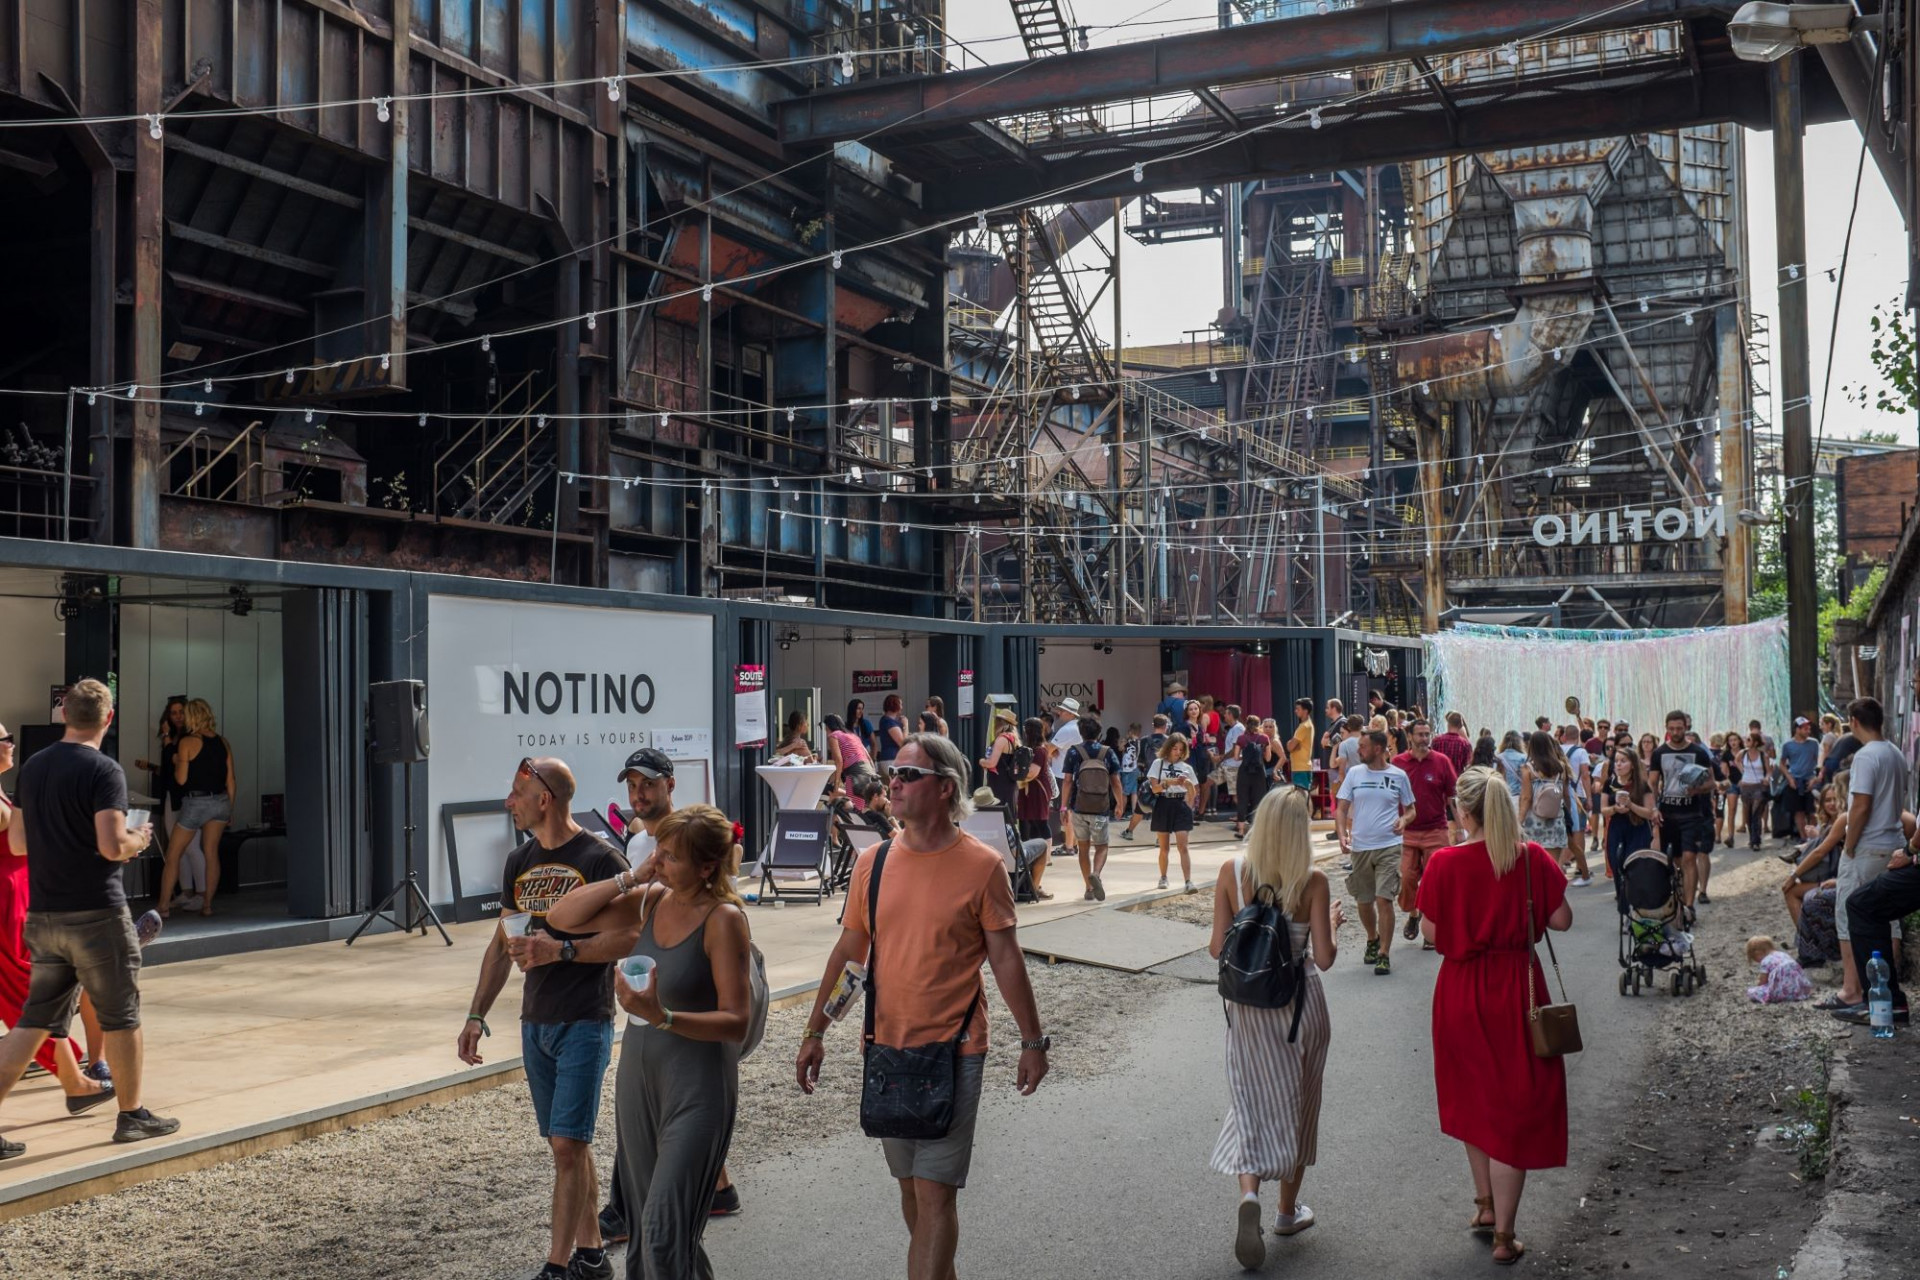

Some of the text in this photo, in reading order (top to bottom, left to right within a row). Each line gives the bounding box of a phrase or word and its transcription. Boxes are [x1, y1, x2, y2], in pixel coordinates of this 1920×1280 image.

[503, 671, 655, 715] NOTINO
[1040, 682, 1093, 697] NGTON
[517, 732, 646, 747] TODAY IS YOURS
[519, 876, 580, 900] REPLAY
[481, 901, 503, 912] NOTIN
